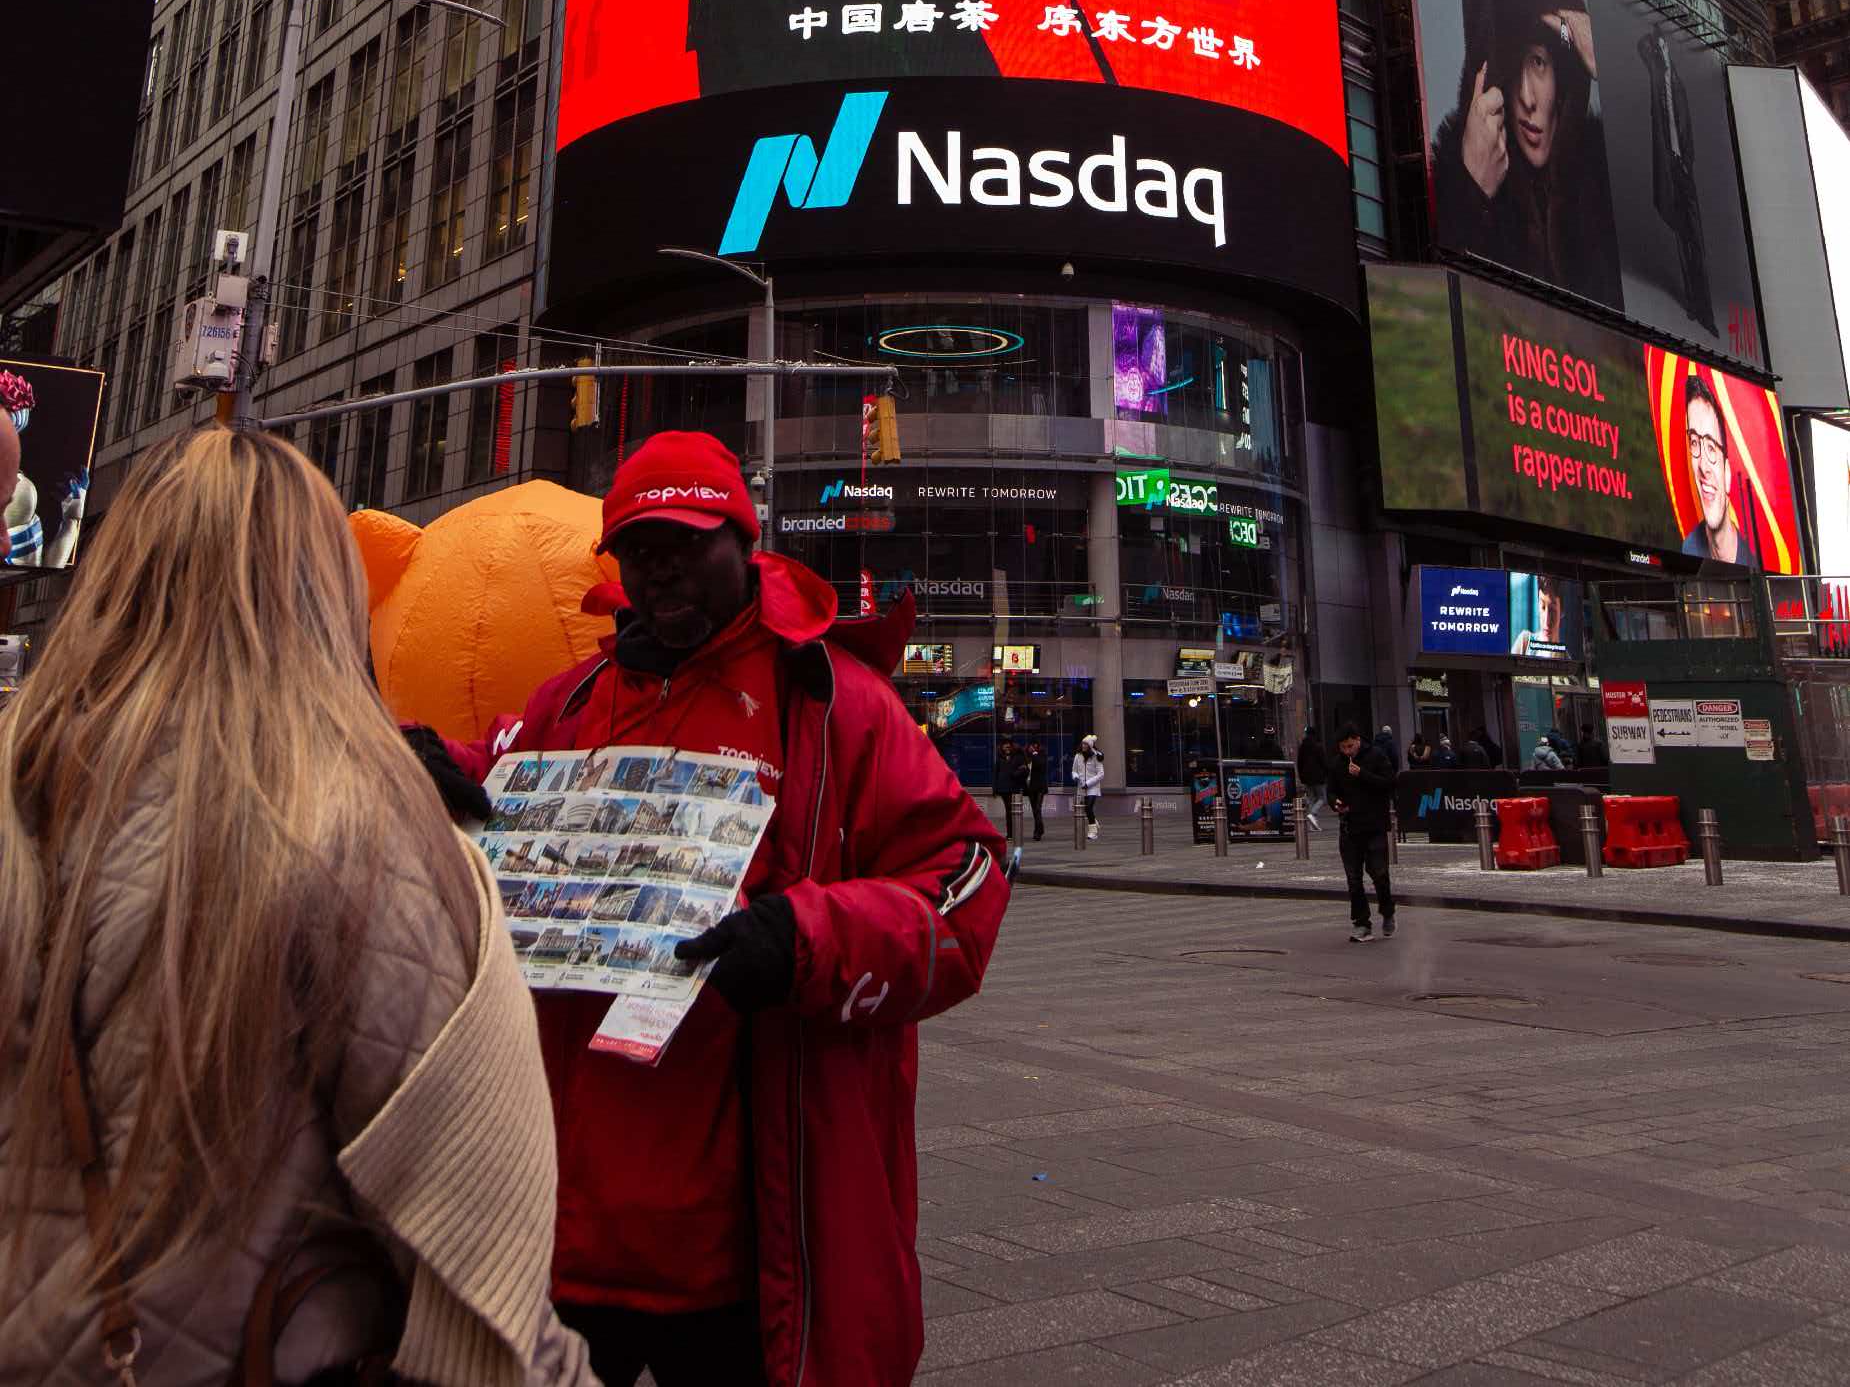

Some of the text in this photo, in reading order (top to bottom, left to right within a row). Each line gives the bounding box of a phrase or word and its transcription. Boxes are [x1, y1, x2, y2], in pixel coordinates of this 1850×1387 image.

[788, 0, 1262, 71] 中国唐茶 序东方世界
[897, 130, 1226, 248] Nasdaq
[1503, 334, 1605, 402] KING SOL
[1507, 382, 1619, 460] is a country
[1513, 444, 1633, 500] rapper now.
[844, 484, 1057, 500] Nasdaq REWRITE TOMORROW
[914, 578, 984, 599] Nasdaq
[1162, 587, 1195, 604] Nasdaq
[1440, 606, 1490, 617] REWRITE
[1431, 621, 1500, 634] TOMORROW
[1702, 703, 1733, 713] DANGER
[1699, 716, 1740, 724] AUTHORIZED
[1611, 725, 1647, 741] SUBWAY
